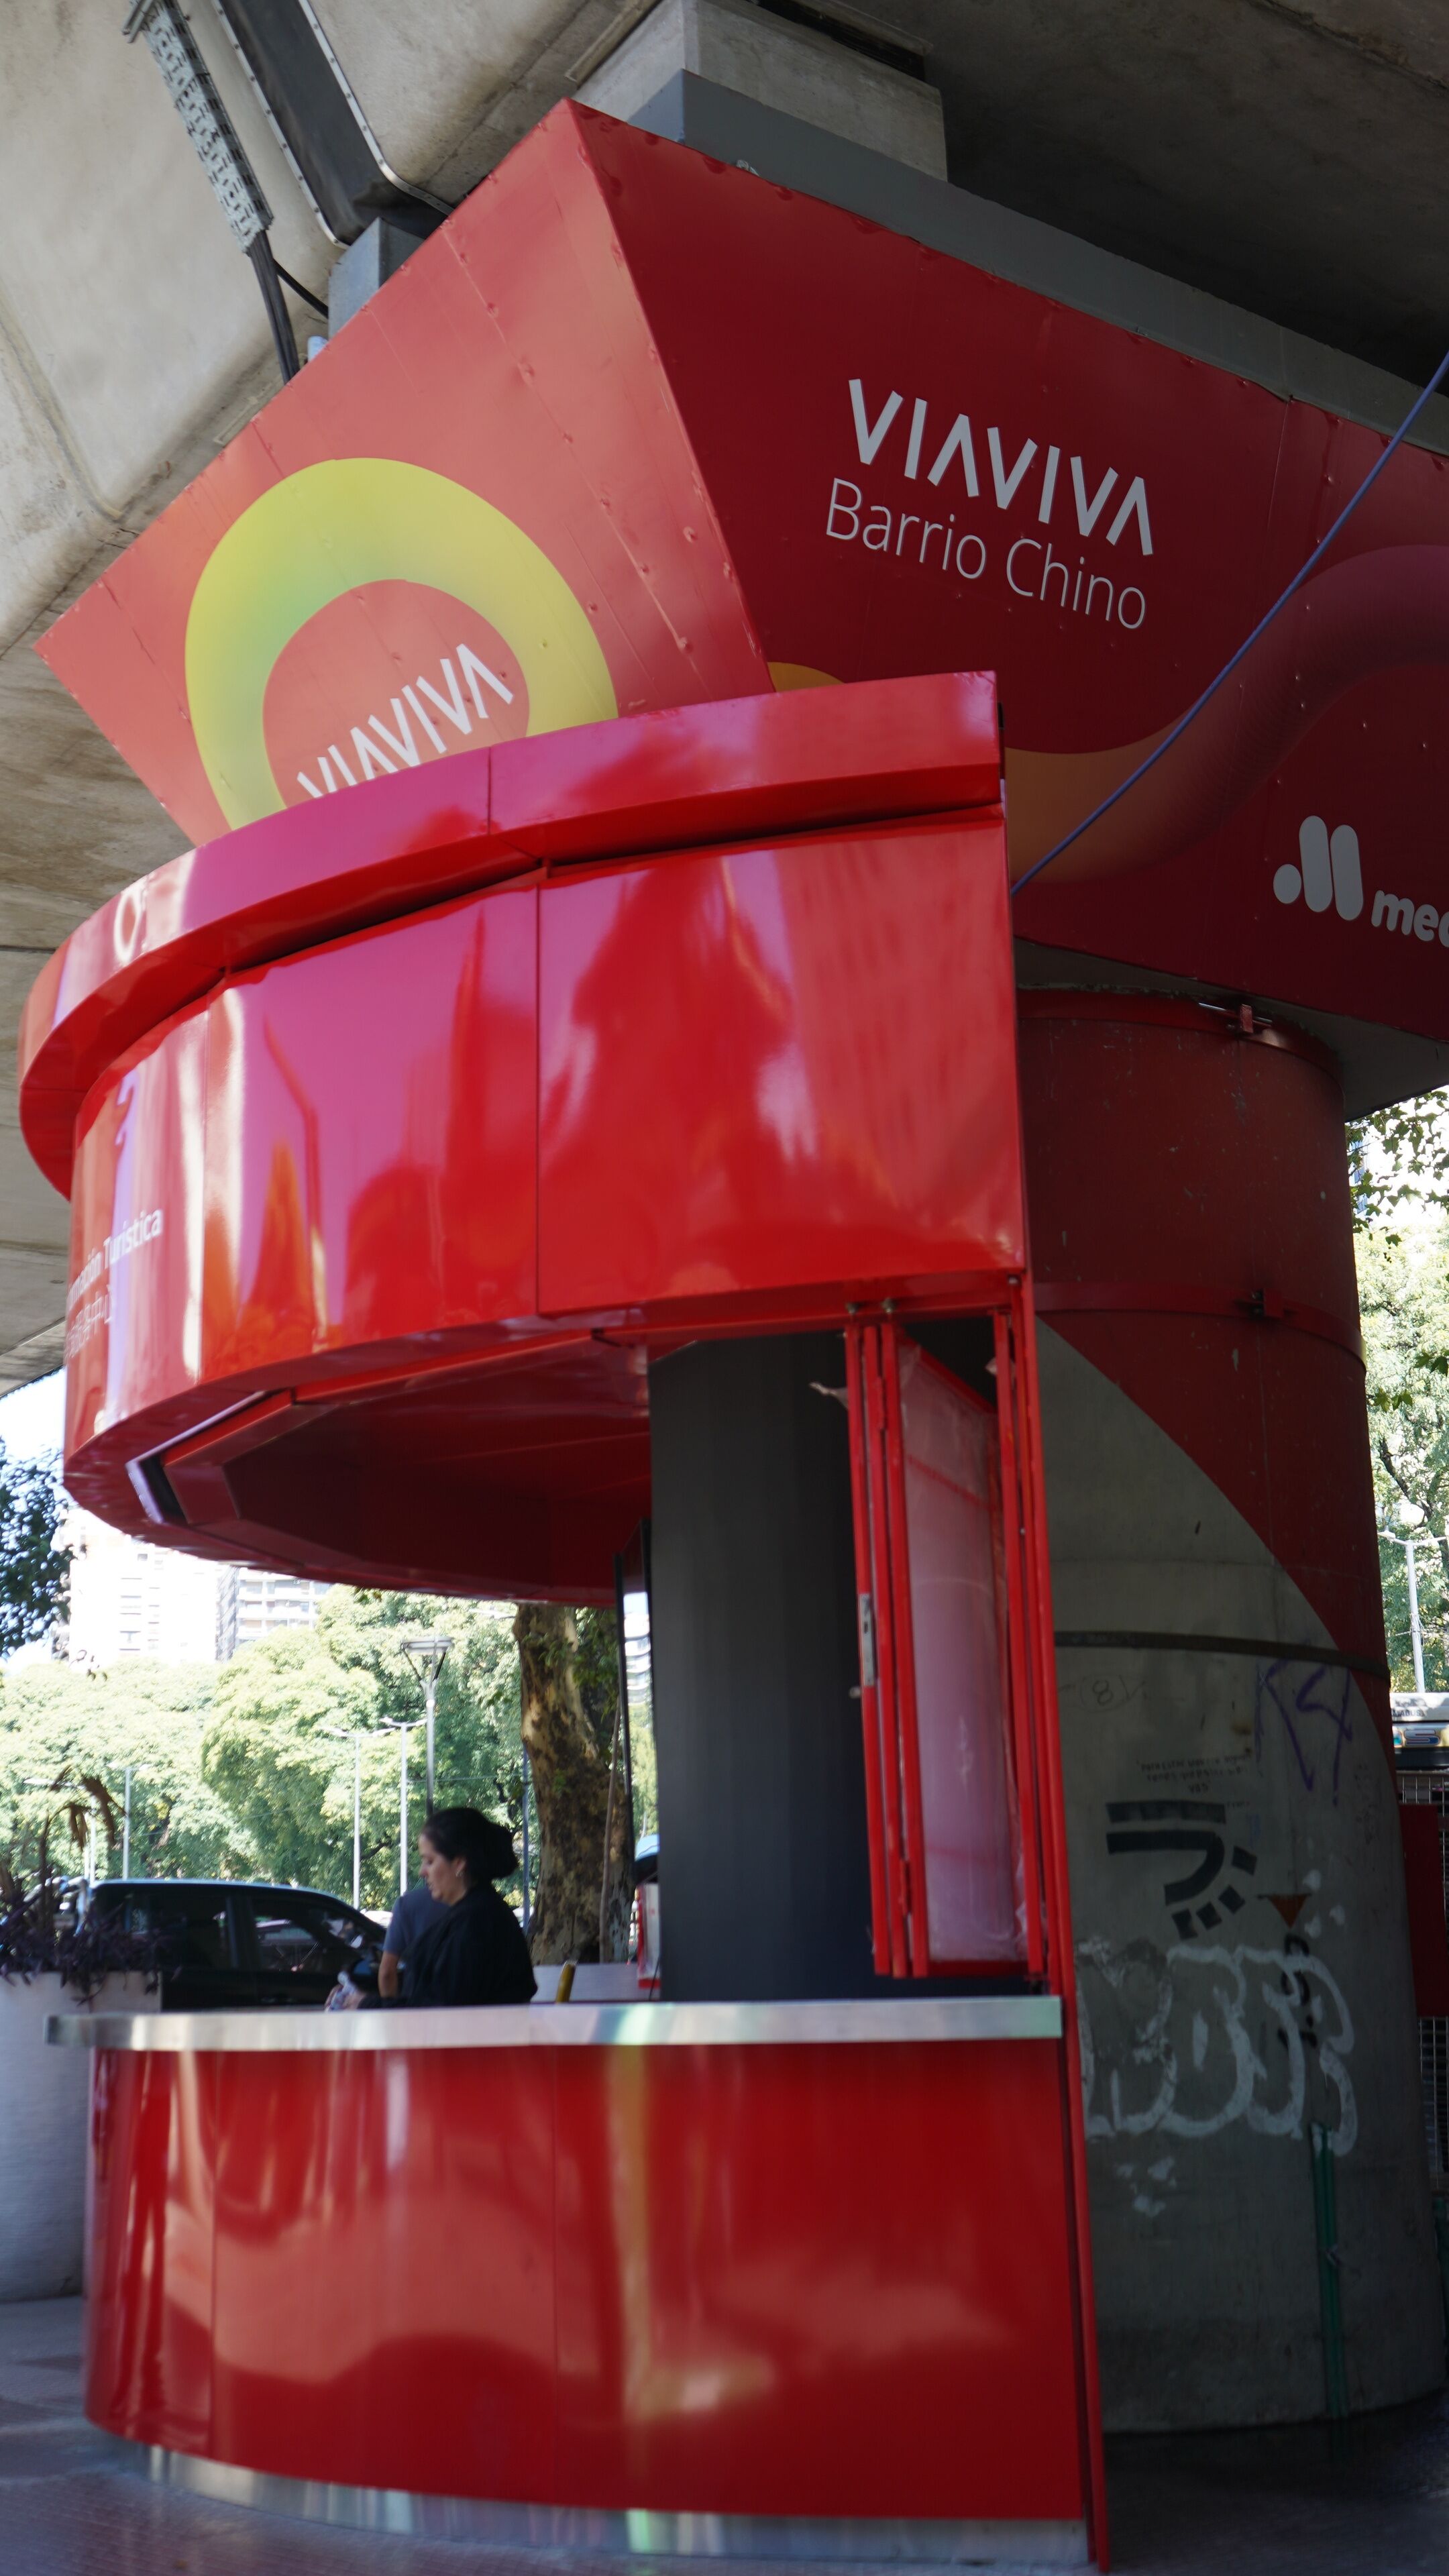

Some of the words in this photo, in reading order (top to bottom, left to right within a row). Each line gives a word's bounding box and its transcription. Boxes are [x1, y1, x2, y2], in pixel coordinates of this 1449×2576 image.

[848, 378, 1153, 556] VIAVIVA
[826, 477, 987, 580] Barrio
[1006, 537, 1146, 630] Chino
[103, 1209, 164, 1269] Turística
